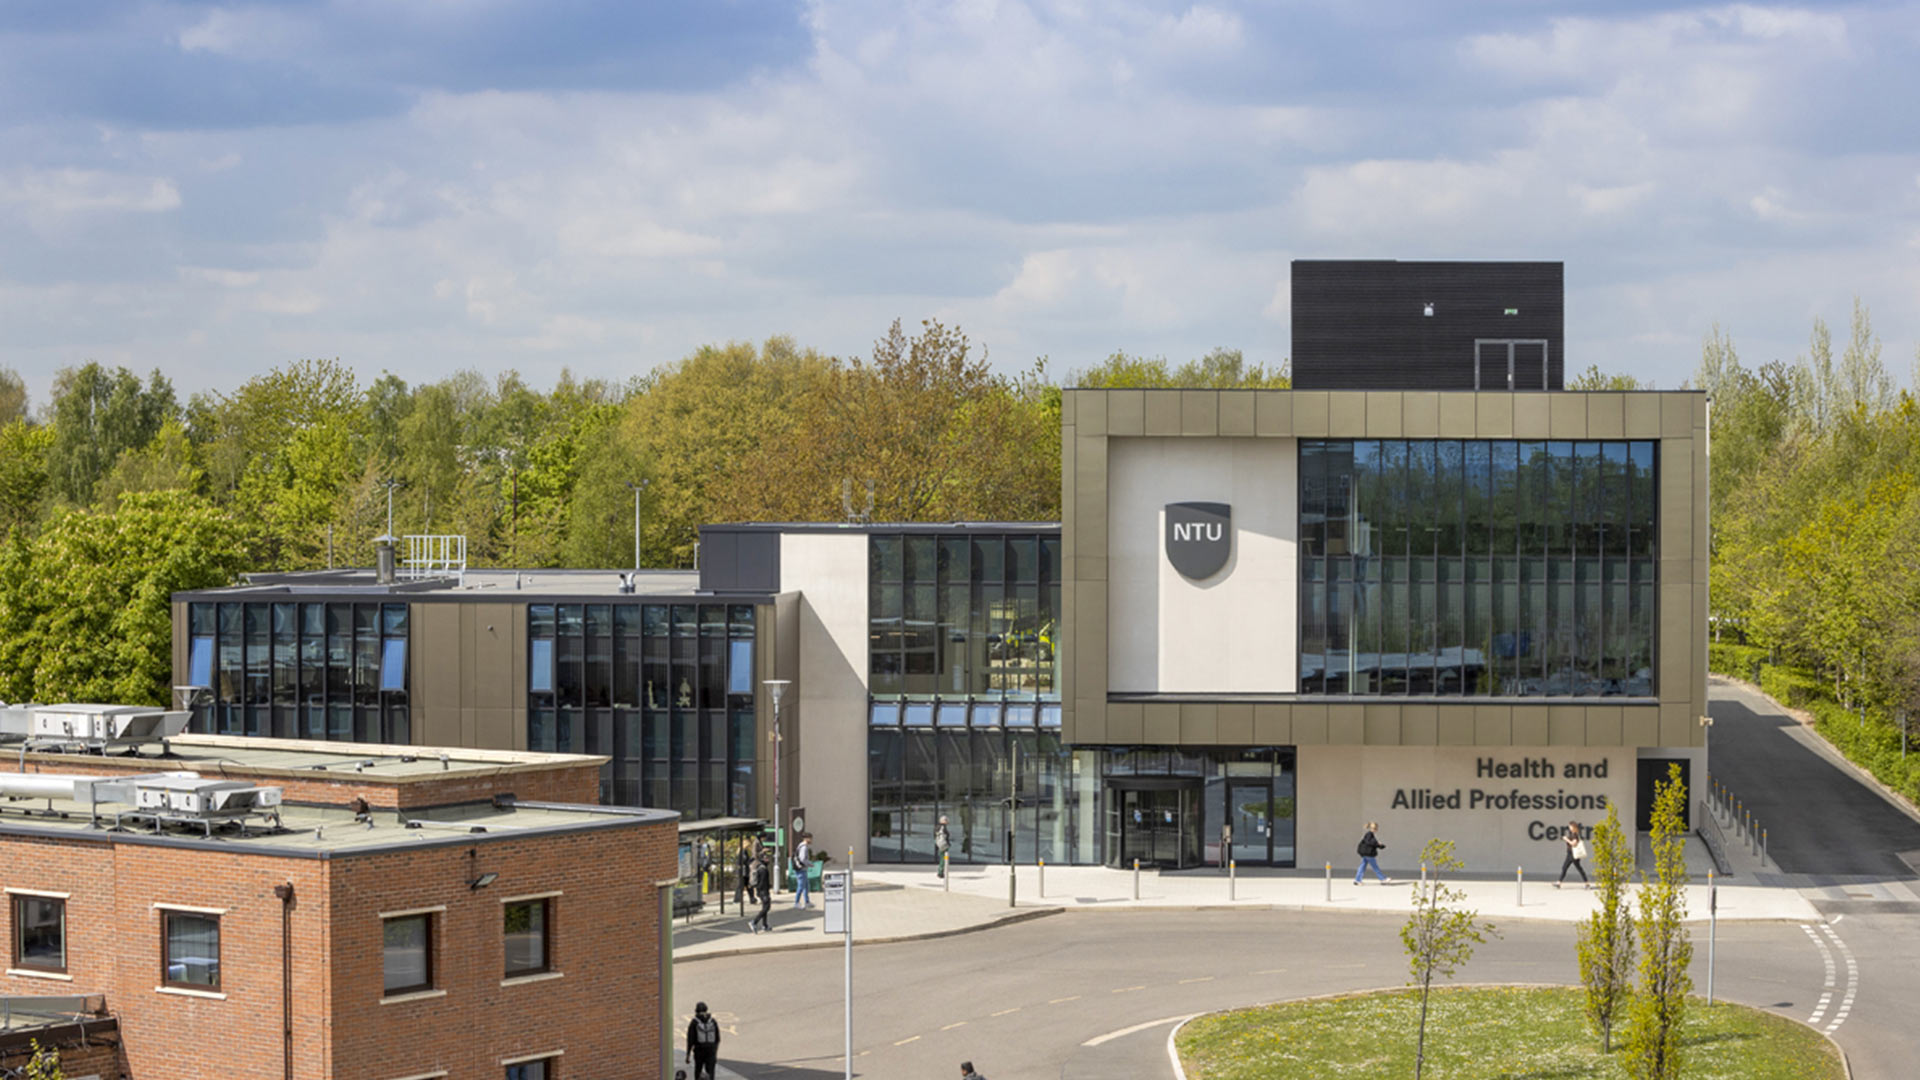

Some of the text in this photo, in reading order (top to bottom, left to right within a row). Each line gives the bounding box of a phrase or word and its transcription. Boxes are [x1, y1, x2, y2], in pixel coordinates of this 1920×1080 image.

[1174, 523, 1222, 541] NTU
[1476, 757, 1609, 778] Health and
[1391, 788, 1608, 809] Allied Professions
[1528, 820, 1597, 841] Centr
